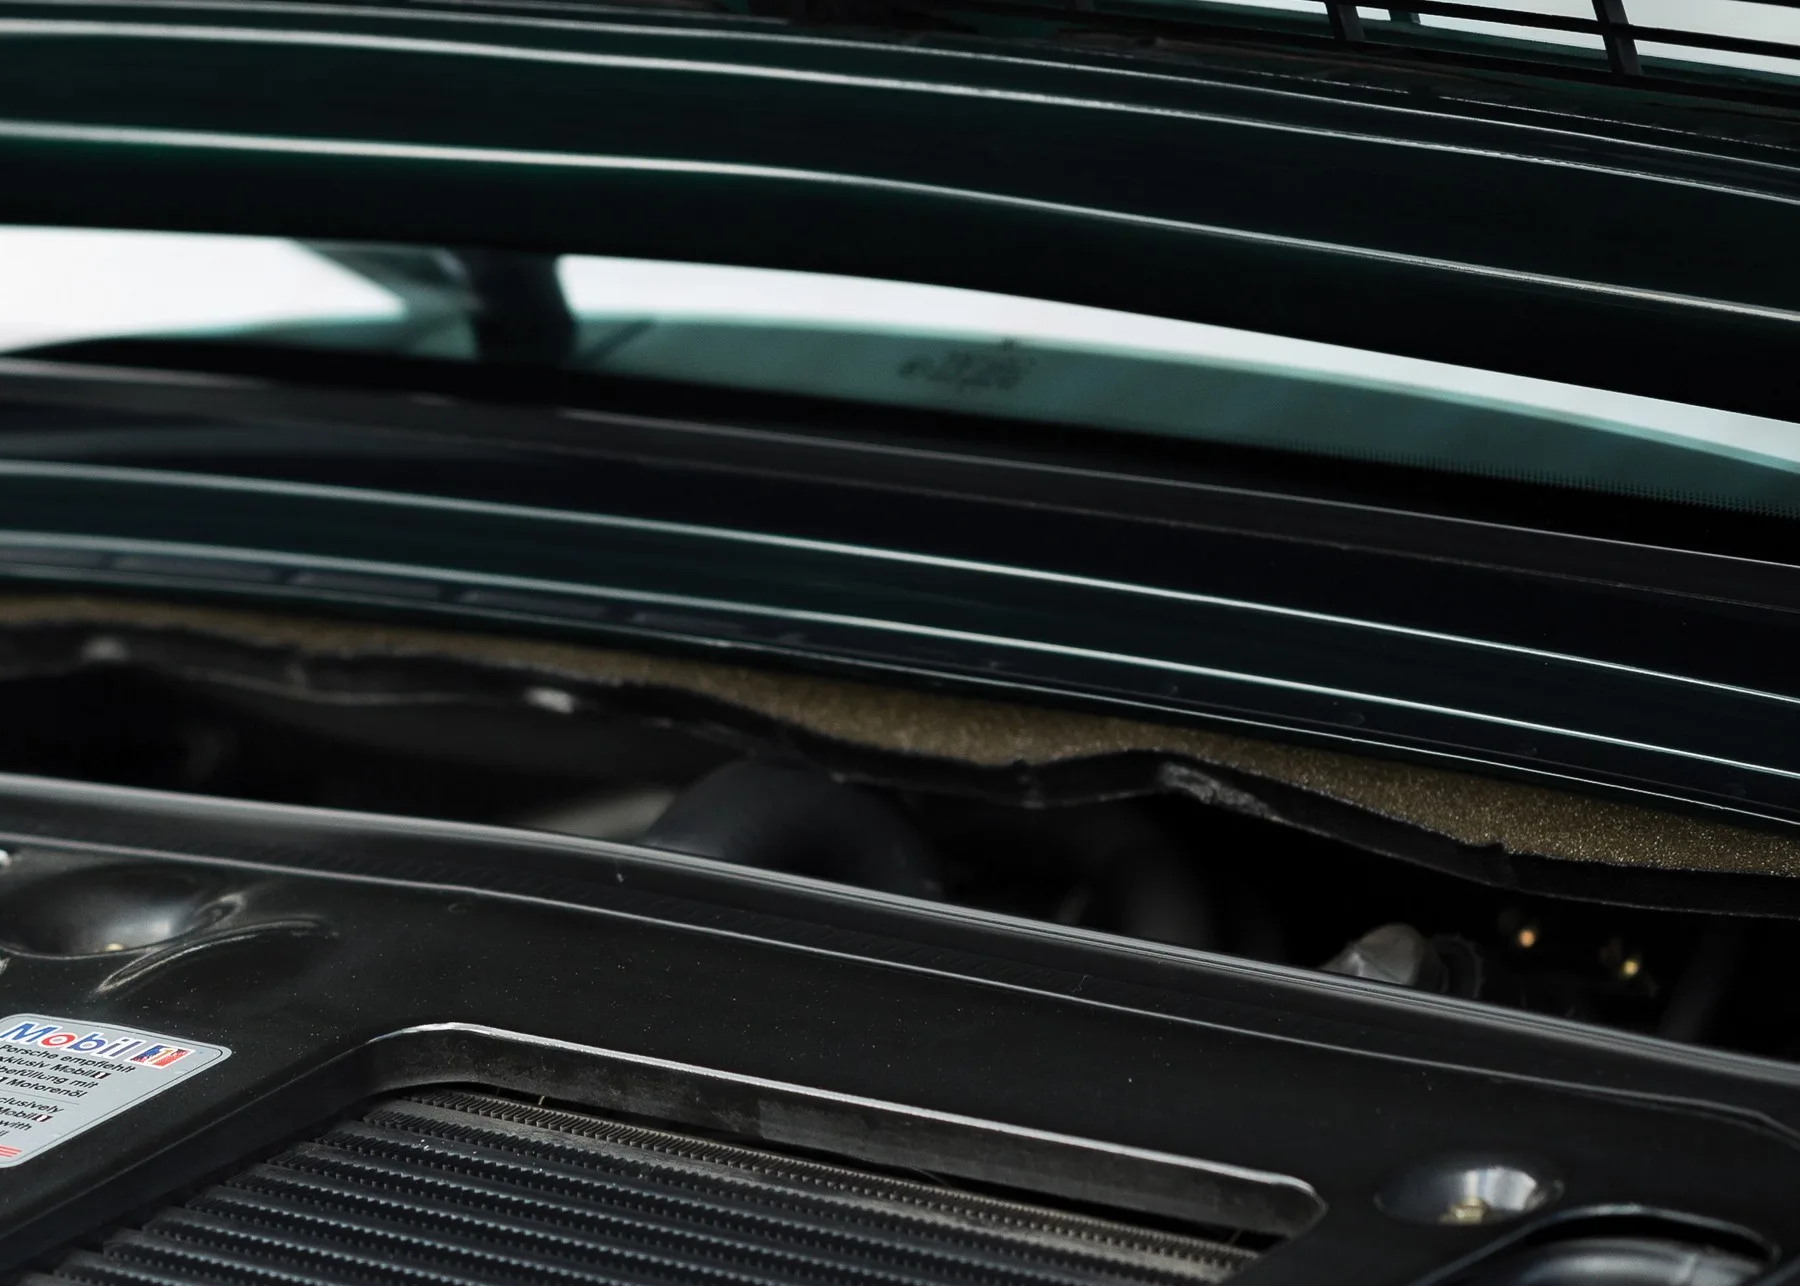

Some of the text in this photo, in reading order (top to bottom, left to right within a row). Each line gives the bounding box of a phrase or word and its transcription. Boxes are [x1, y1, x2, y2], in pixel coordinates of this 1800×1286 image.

[60, 1056, 136, 1073] empfiehlt
[5, 1078, 88, 1098] Motorenöl
[69, 1080, 98, 1088] mit
